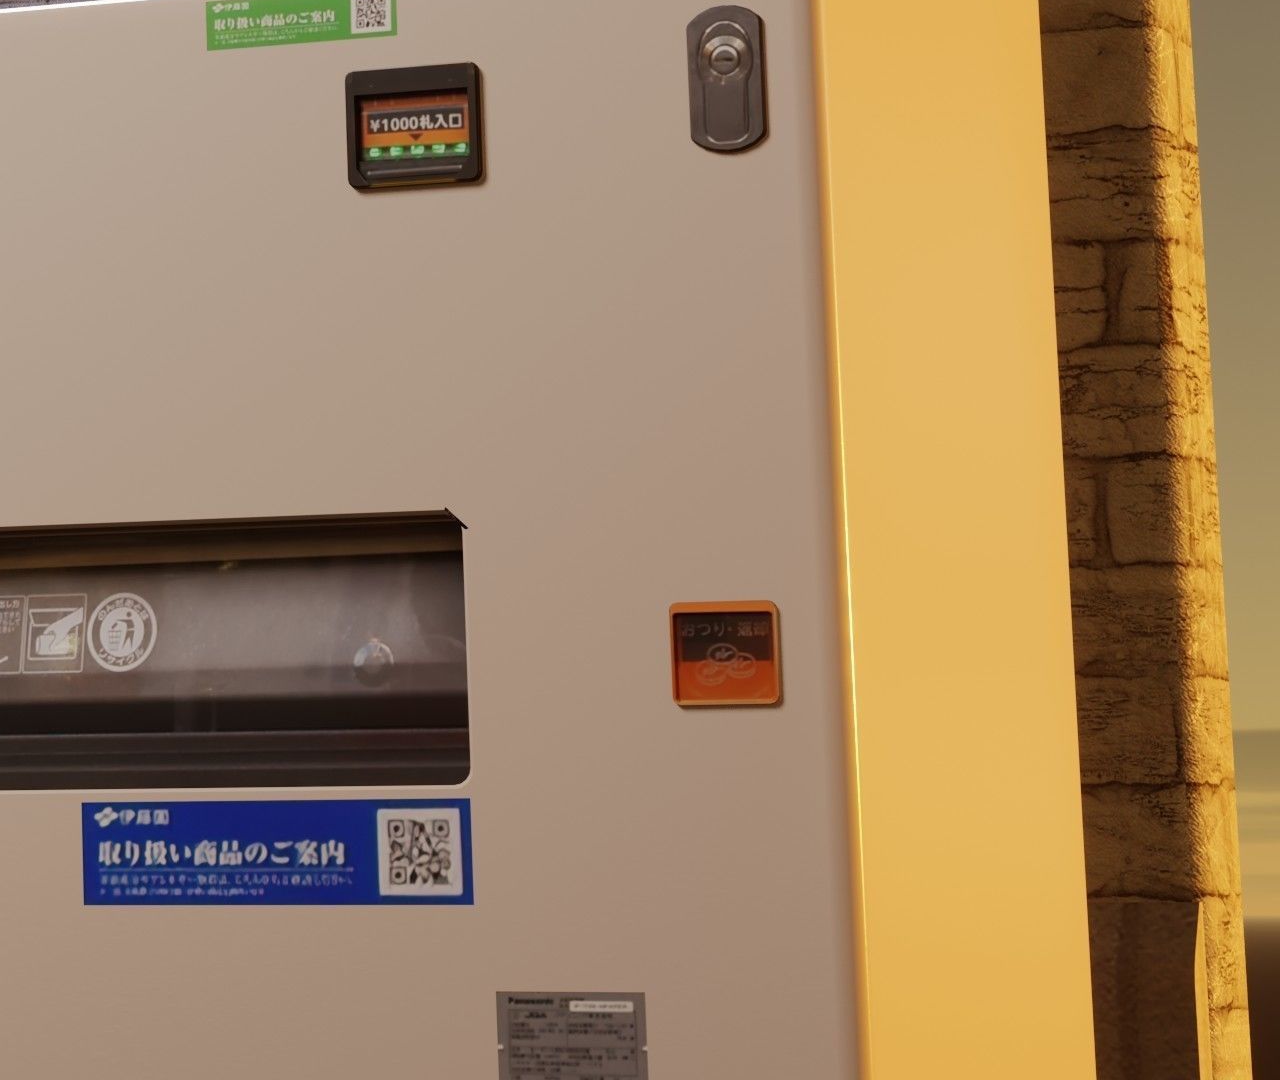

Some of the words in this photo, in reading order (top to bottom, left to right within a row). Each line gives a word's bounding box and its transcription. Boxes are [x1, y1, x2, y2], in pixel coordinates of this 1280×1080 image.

[214, 9, 336, 32] 取り扱い商品のご案内
[369, 112, 463, 133] ¥1000札入口
[97, 838, 346, 867] 取り扱い商品のご案内
